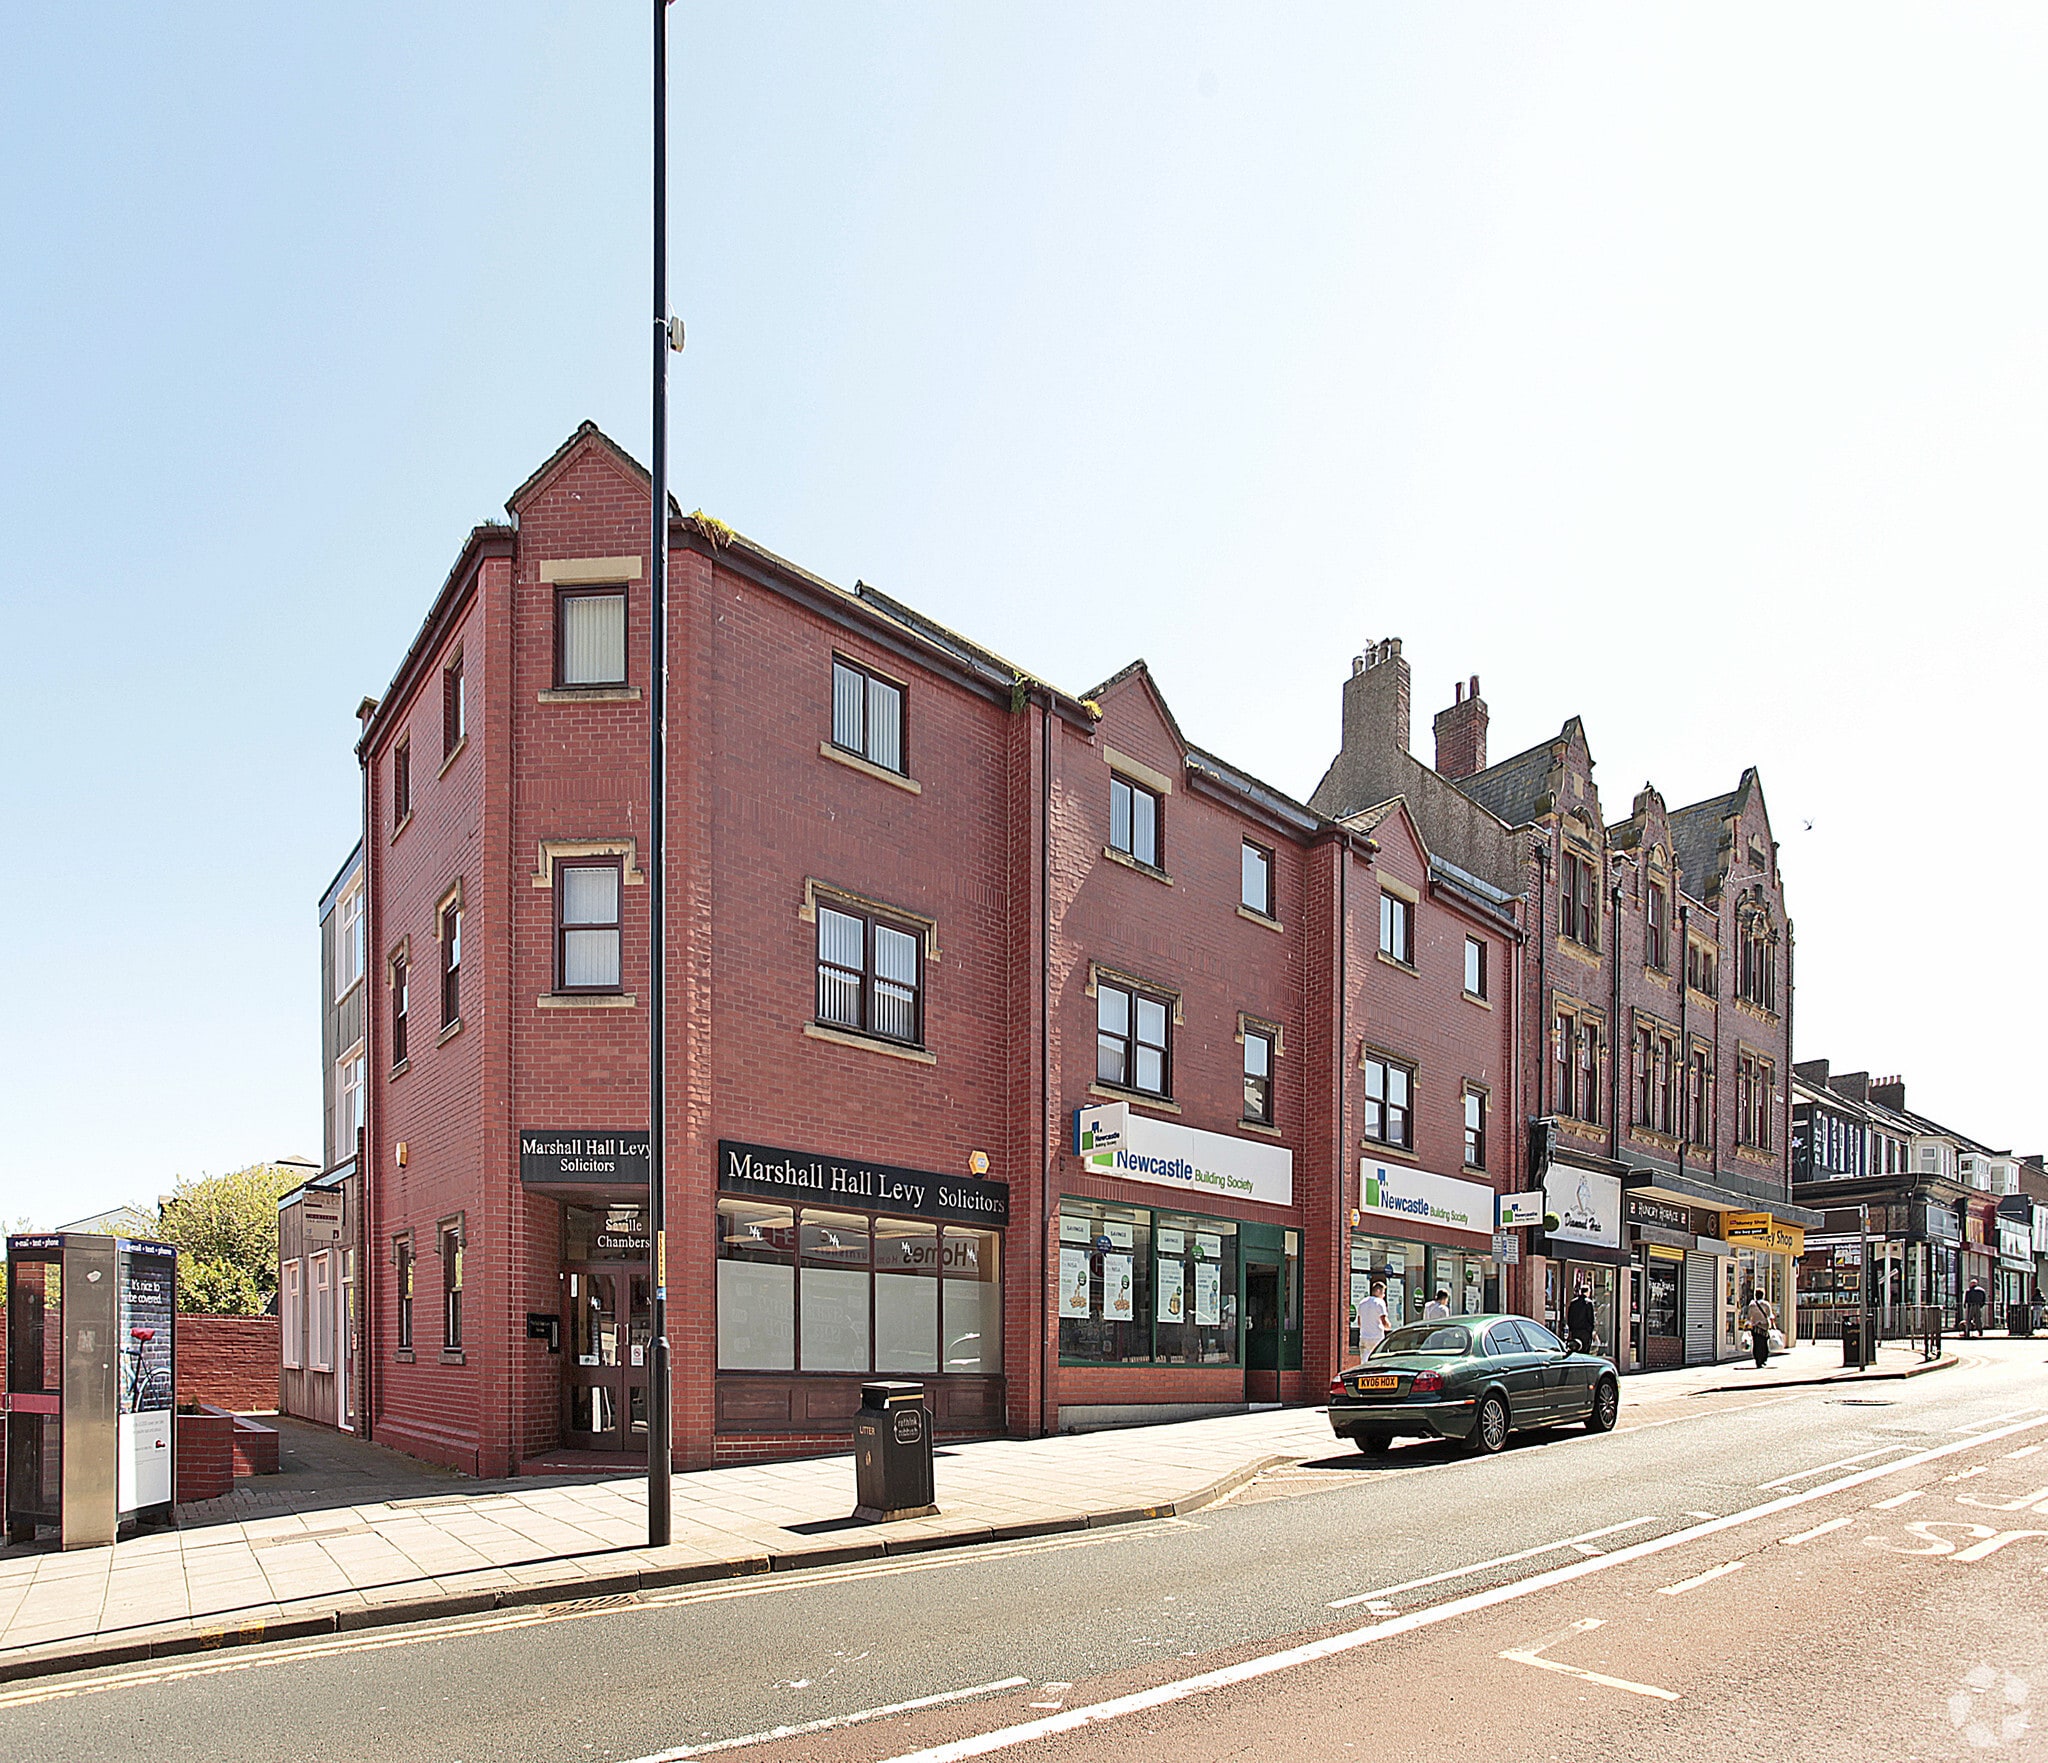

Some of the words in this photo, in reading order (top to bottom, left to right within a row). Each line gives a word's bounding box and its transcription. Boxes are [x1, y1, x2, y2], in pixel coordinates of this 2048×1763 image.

[522, 1139, 582, 1155] Marshall
[586, 1139, 615, 1156] Hall
[619, 1140, 651, 1160] Levy
[560, 1158, 615, 1172] Solicitors
[1116, 1150, 1193, 1181] Newcastle
[1195, 1169, 1225, 1190] Building
[1227, 1175, 1254, 1194] Society
[728, 1151, 824, 1190] Marshall
[830, 1167, 873, 1196] Hall
[878, 1174, 926, 1208] Levy
[938, 1186, 1006, 1214] Solicitors
[1381, 1189, 1430, 1216] Newcastle
[1430, 1205, 1450, 1222] Building
[1451, 1208, 1469, 1226] Society
[605, 1218, 642, 1231] Saville
[597, 1235, 650, 1248] Chambers
[1776, 1230, 1793, 1249] Shop
[128, 1291, 137, 1303] be
[1361, 1377, 1379, 1388] KY06
[860, 1425, 876, 1436] LITTER
